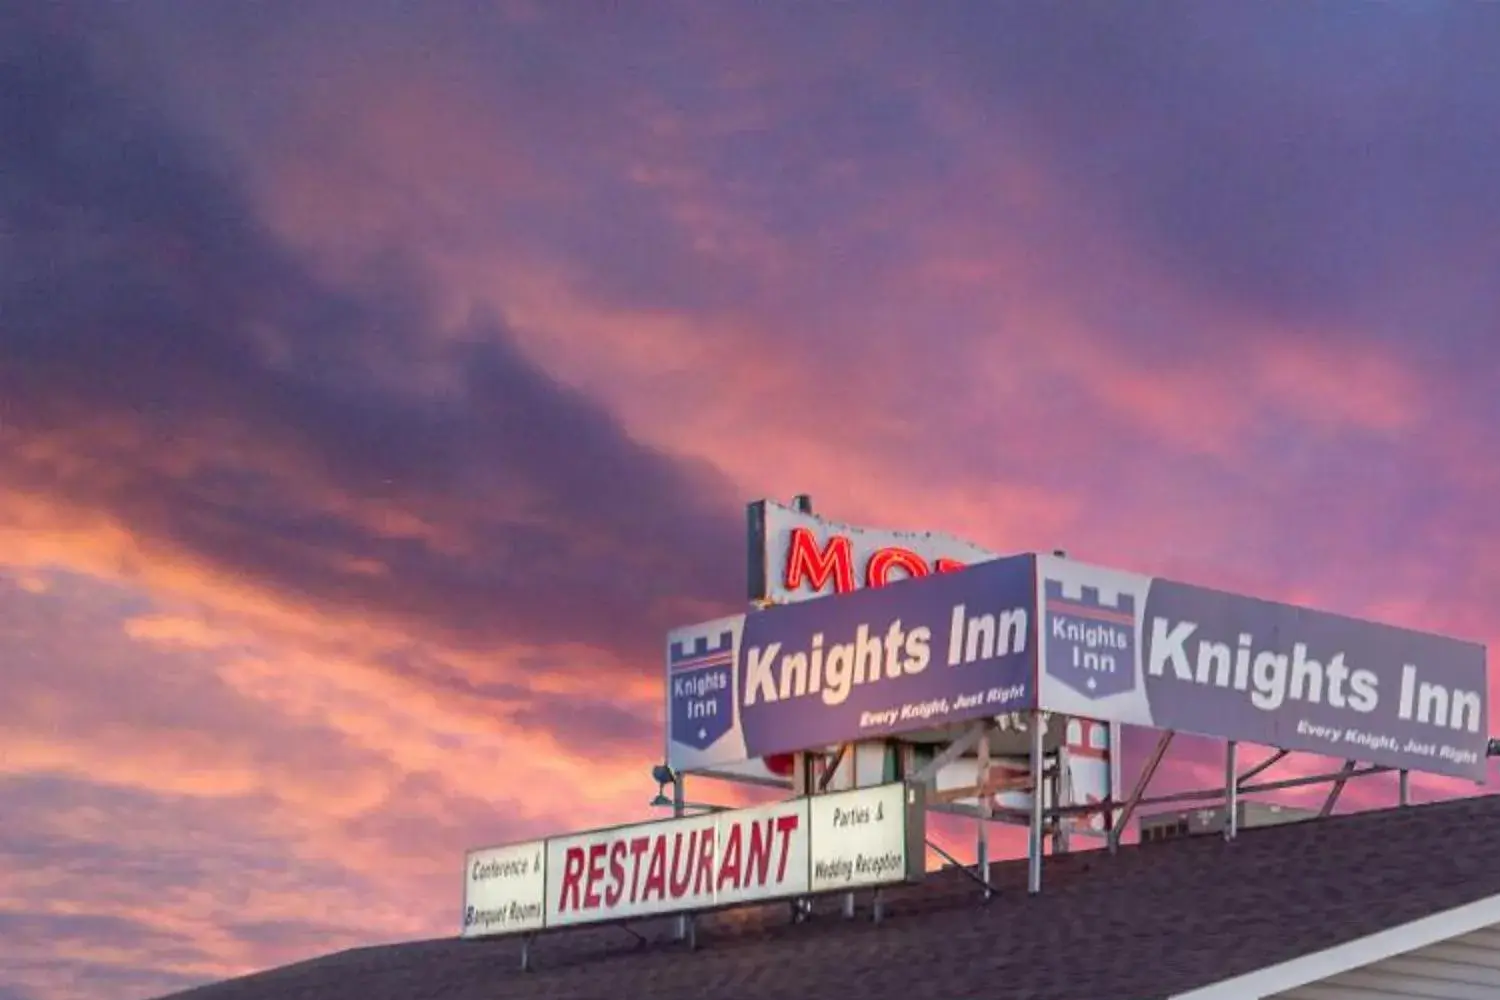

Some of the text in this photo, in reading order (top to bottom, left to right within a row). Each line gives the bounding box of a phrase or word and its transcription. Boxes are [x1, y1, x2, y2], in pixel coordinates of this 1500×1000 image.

[785, 526, 969, 595] MO
[1053, 615, 1128, 650] Knights
[743, 603, 1029, 706] Knights Inn
[1072, 644, 1116, 674] Inn
[674, 671, 728, 699] Knights
[1147, 616, 1482, 734] Knights Inn
[687, 698, 718, 719] Inn
[858, 683, 1026, 728] Every Knight, Just Right
[1296, 718, 1479, 765] Every Knight, Just Right
[832, 806, 871, 828] Parties
[471, 857, 528, 881] Conference
[557, 814, 800, 914] RESTAURANT
